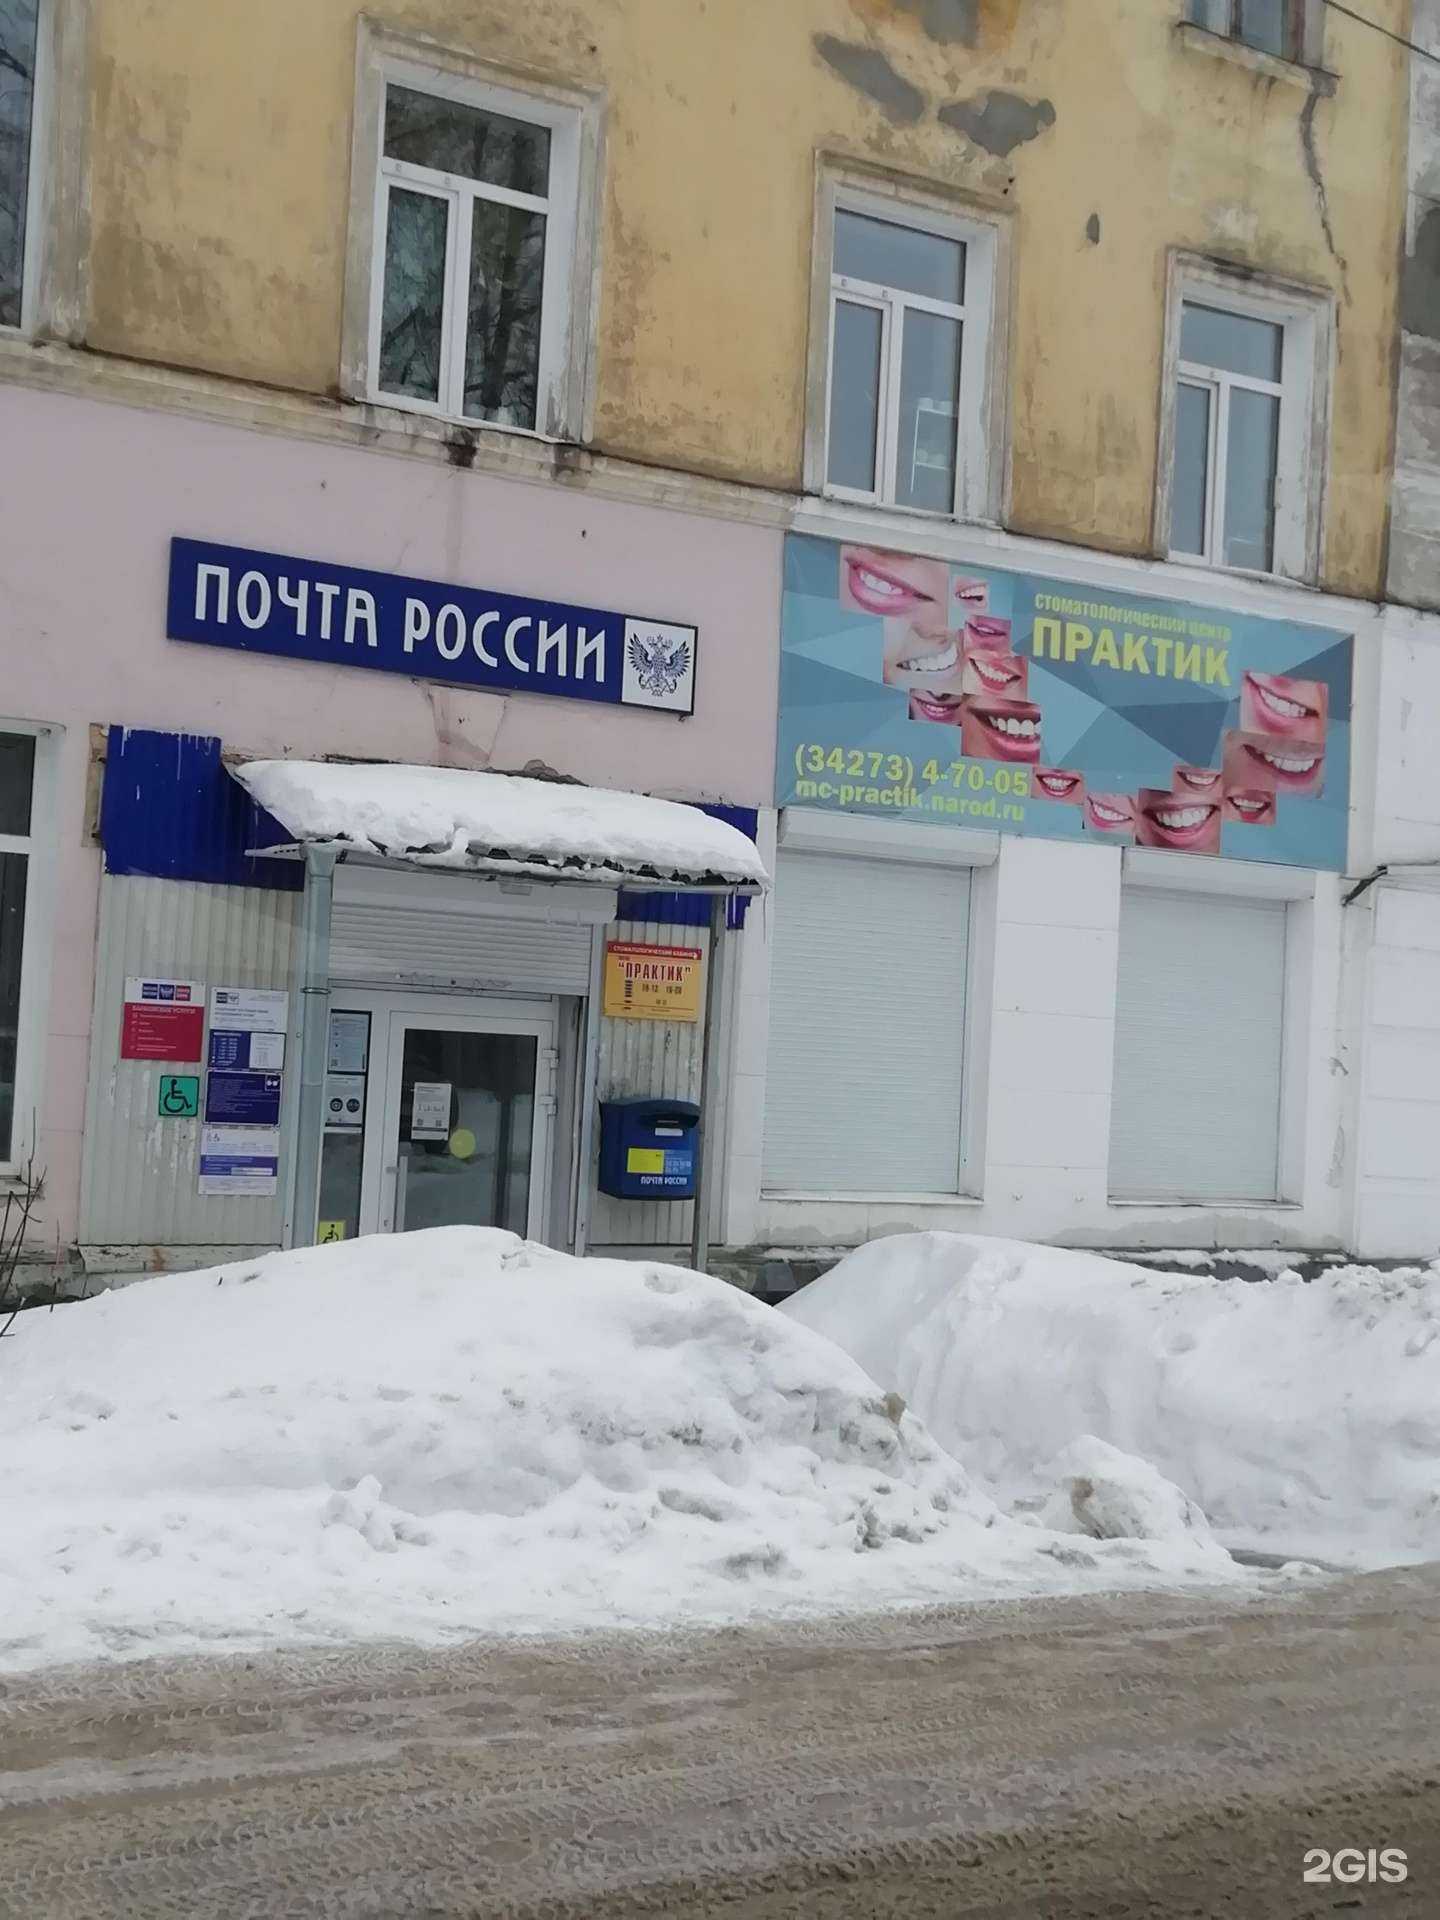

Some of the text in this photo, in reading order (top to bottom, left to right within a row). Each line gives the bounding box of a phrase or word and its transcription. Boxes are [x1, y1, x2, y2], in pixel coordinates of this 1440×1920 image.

[195, 562, 606, 683] ПОЧТА РОССИИ
[1032, 616, 1231, 687] ПРАКТИК
[794, 743, 1029, 797] (34273) 4-70-05
[795, 778, 1025, 822] mc-practik.narod.ru
